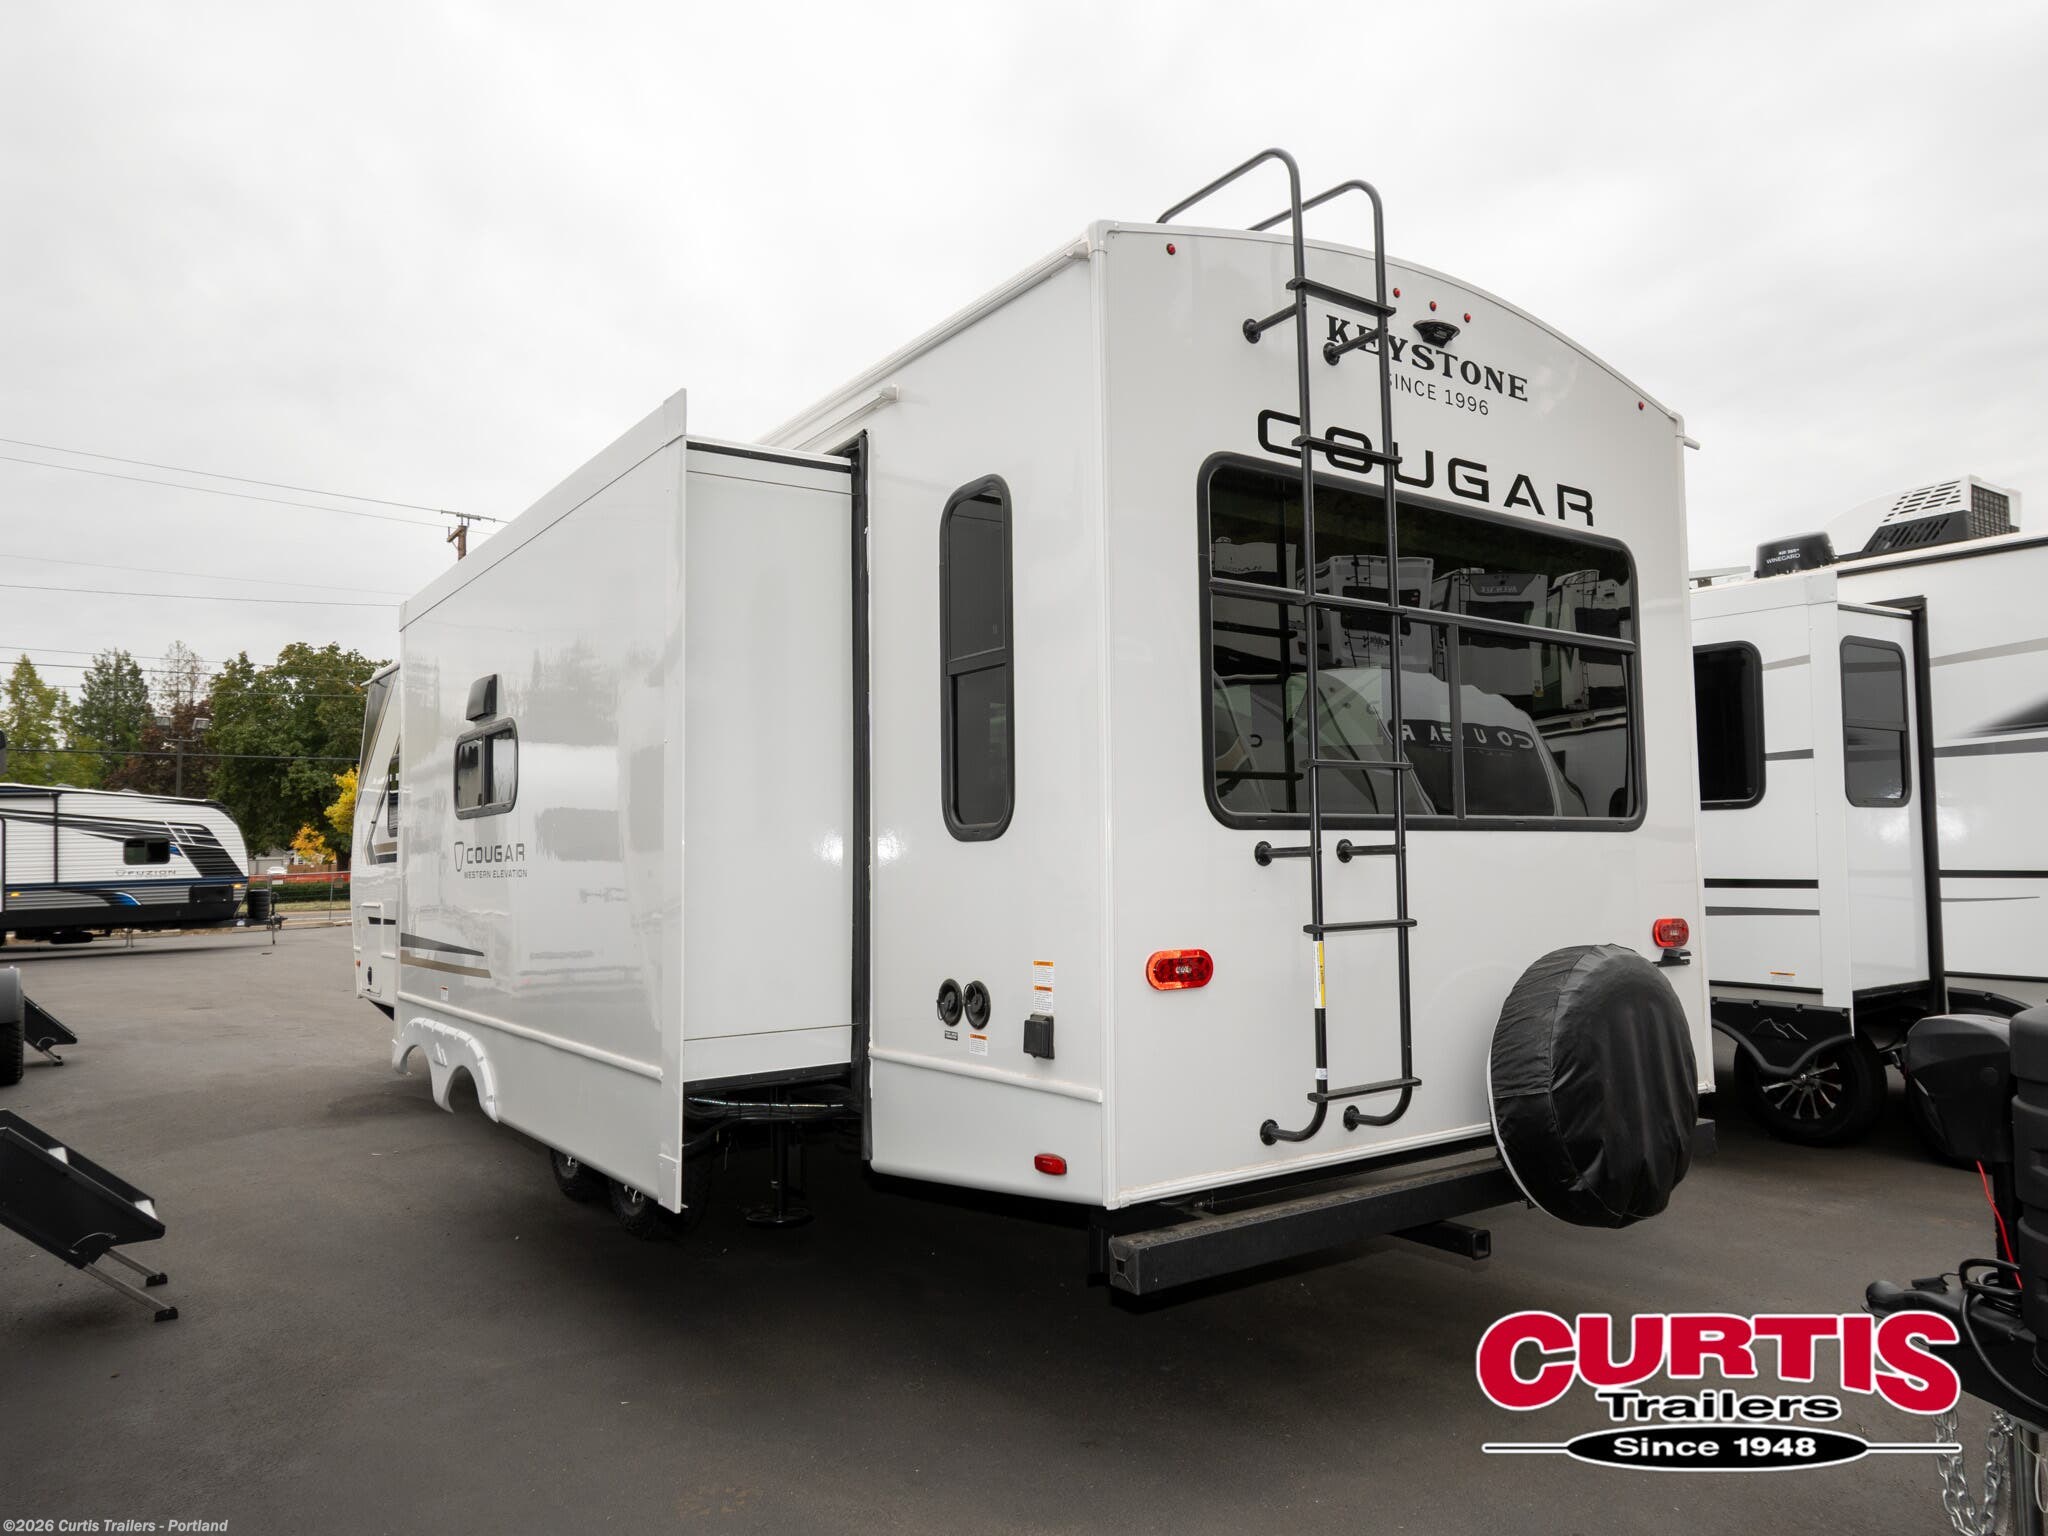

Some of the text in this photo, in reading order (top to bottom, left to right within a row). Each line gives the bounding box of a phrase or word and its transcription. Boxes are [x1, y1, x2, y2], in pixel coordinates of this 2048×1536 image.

[1388, 373, 1489, 416] INCE 1996
[1257, 409, 1594, 527] COUGAR
[466, 843, 525, 864] COUGAR
